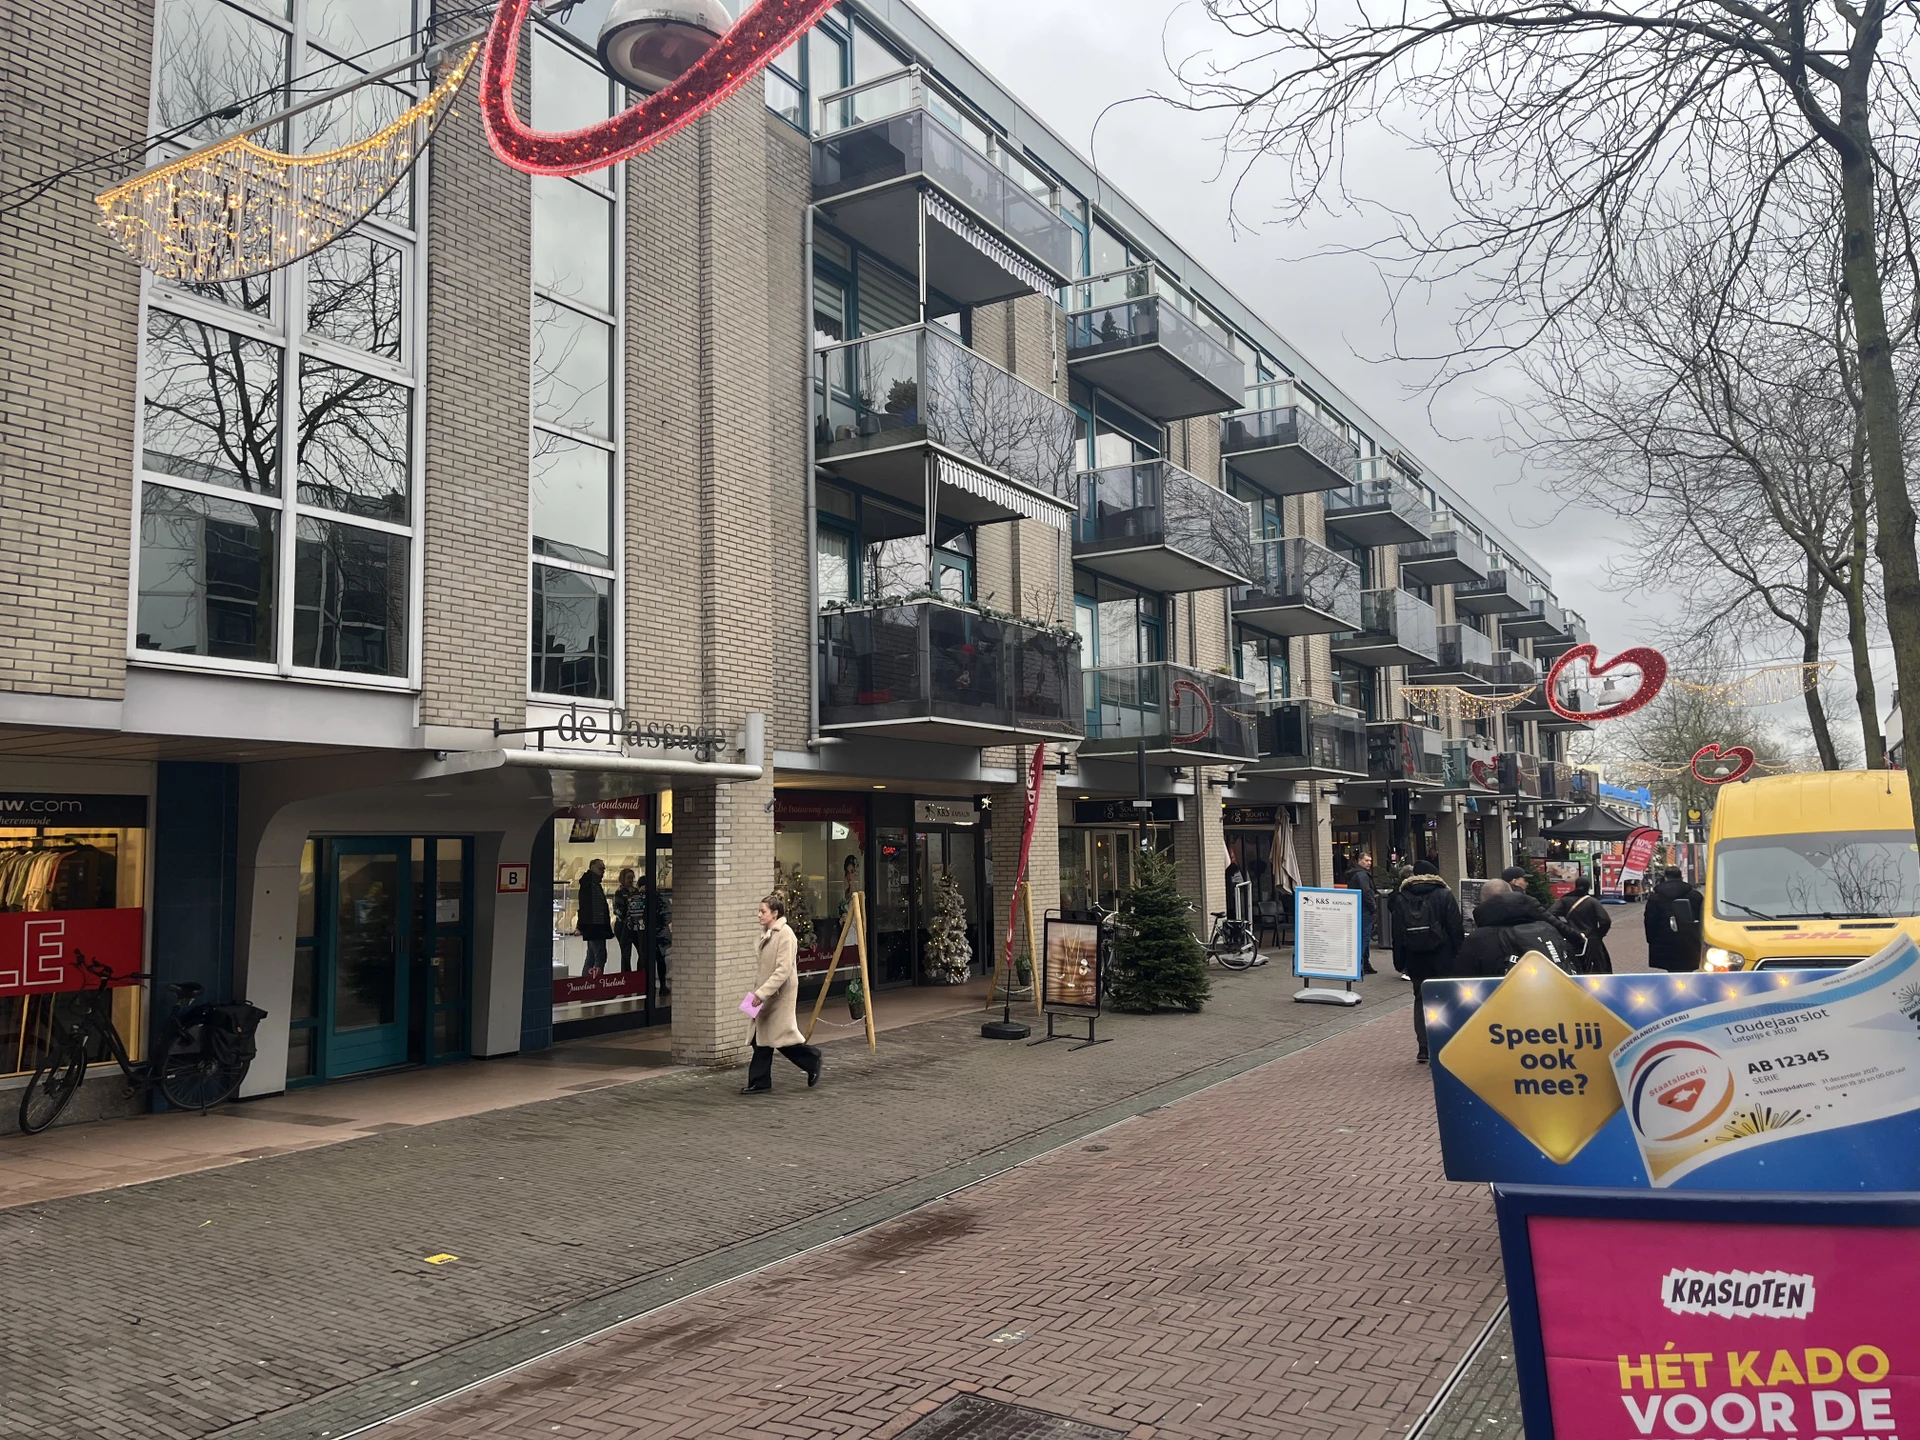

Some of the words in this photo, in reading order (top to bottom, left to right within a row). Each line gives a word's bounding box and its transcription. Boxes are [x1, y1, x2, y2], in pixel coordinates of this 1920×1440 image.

[558, 702, 598, 744] de
[606, 705, 727, 761] Passage
[1636, 838, 1652, 849] 10%
[509, 872, 518, 885] B
[1315, 897, 1330, 905] K&S
[1782, 932, 1856, 940] DHL
[1546, 940, 1561, 963] THULE
[1619, 1024, 1661, 1053] NEDERLANDSE
[1662, 1013, 1690, 1027] LOTERIJ
[1735, 1008, 1830, 1034] Oudejaarslot
[1489, 1022, 1568, 1050] Speel
[1574, 1022, 1603, 1049] jij
[1732, 1032, 1765, 1043] Lotprijs
[1773, 1026, 1798, 1036] 30,00
[1520, 1048, 1577, 1070] ook
[1747, 1059, 1774, 1075] AB
[1774, 1049, 1830, 1069] 12345
[1514, 1073, 1589, 1096] mee?
[1648, 1065, 1708, 1097] Staatsloterij
[1752, 1073, 1780, 1085] SERIE
[1759, 1081, 1817, 1096] Trekkingsdatum:
[1829, 1071, 1862, 1083] december
[1863, 1066, 1879, 1076] 2025
[1825, 1082, 1849, 1092] tussen
[1671, 1277, 1806, 1310] KRASLOTEN
[1617, 1341, 1714, 1389] HÉT
[1727, 1345, 1890, 1388] KADO
[1621, 1392, 1798, 1434] VOOR
[1811, 1388, 1896, 1433] DE
